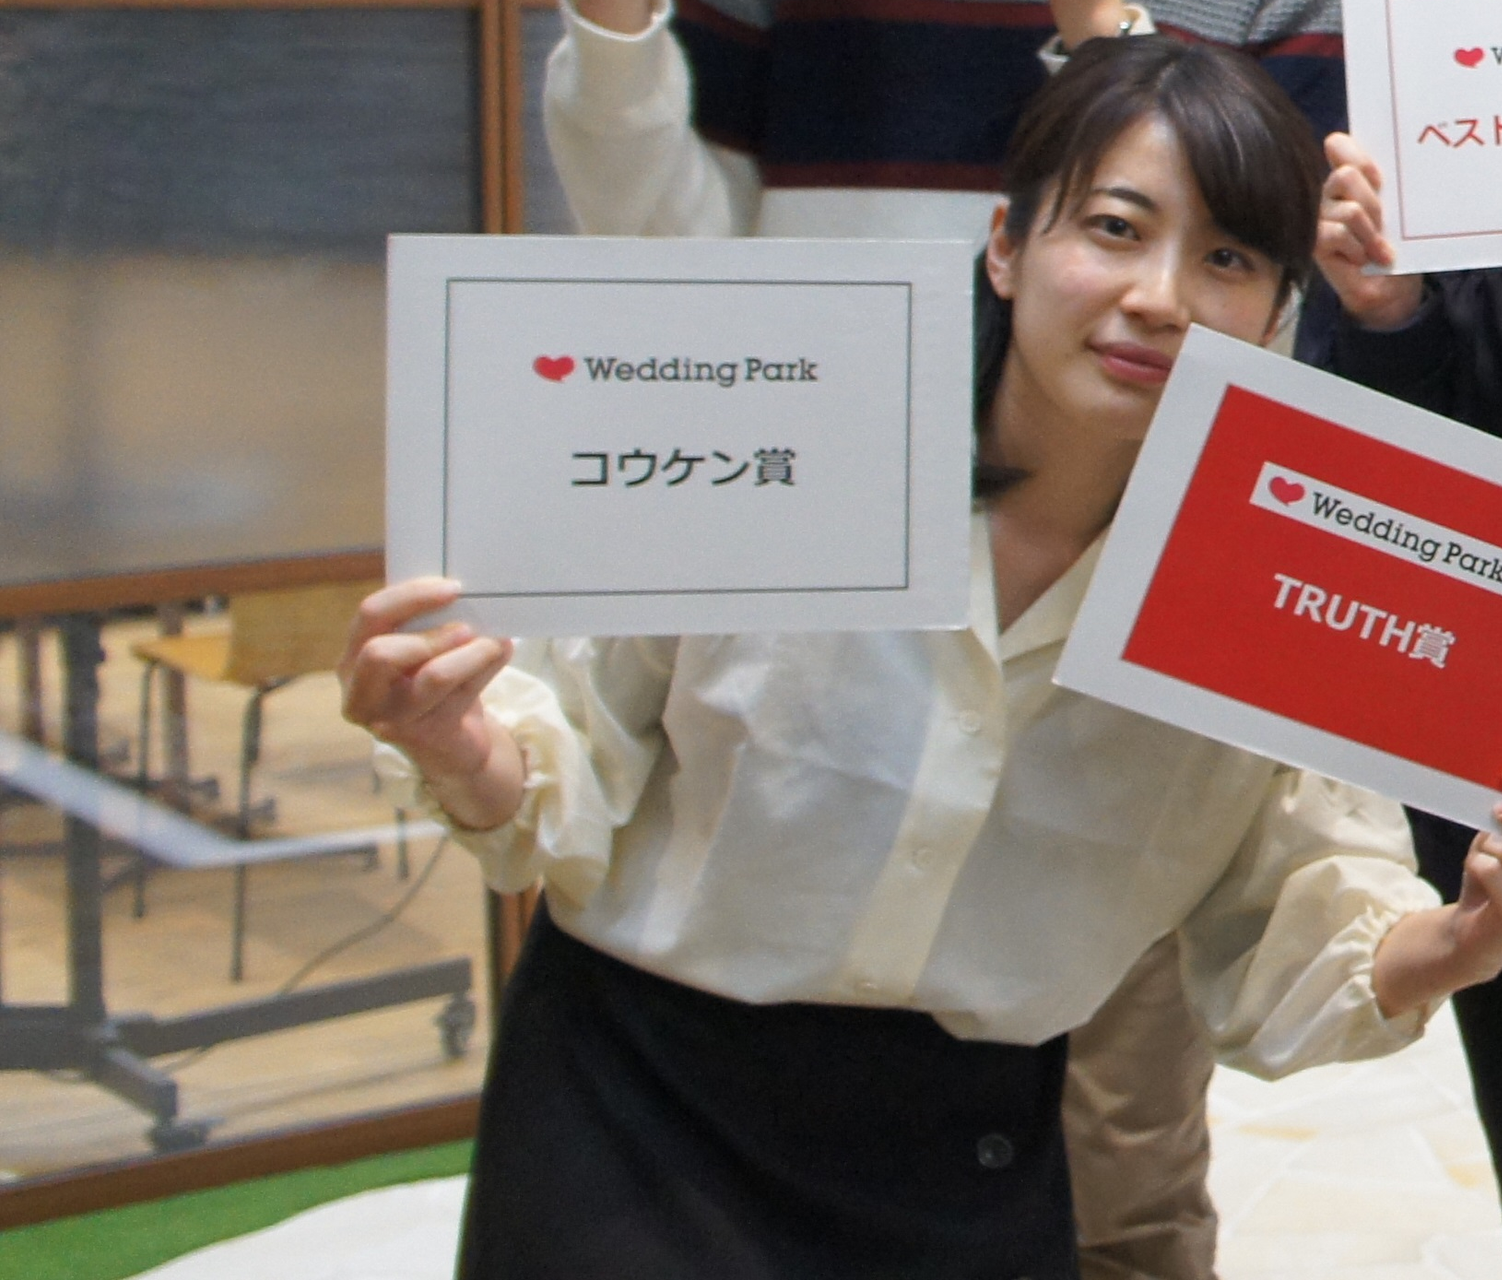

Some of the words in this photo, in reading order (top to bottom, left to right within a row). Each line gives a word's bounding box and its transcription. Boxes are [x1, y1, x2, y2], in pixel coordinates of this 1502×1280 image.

[583, 356, 739, 388] Wedding
[743, 356, 819, 382] Park
[570, 446, 797, 488] コウケン賞
[1311, 490, 1444, 564] Wedding
[1272, 572, 1456, 669] TRUTH賞
